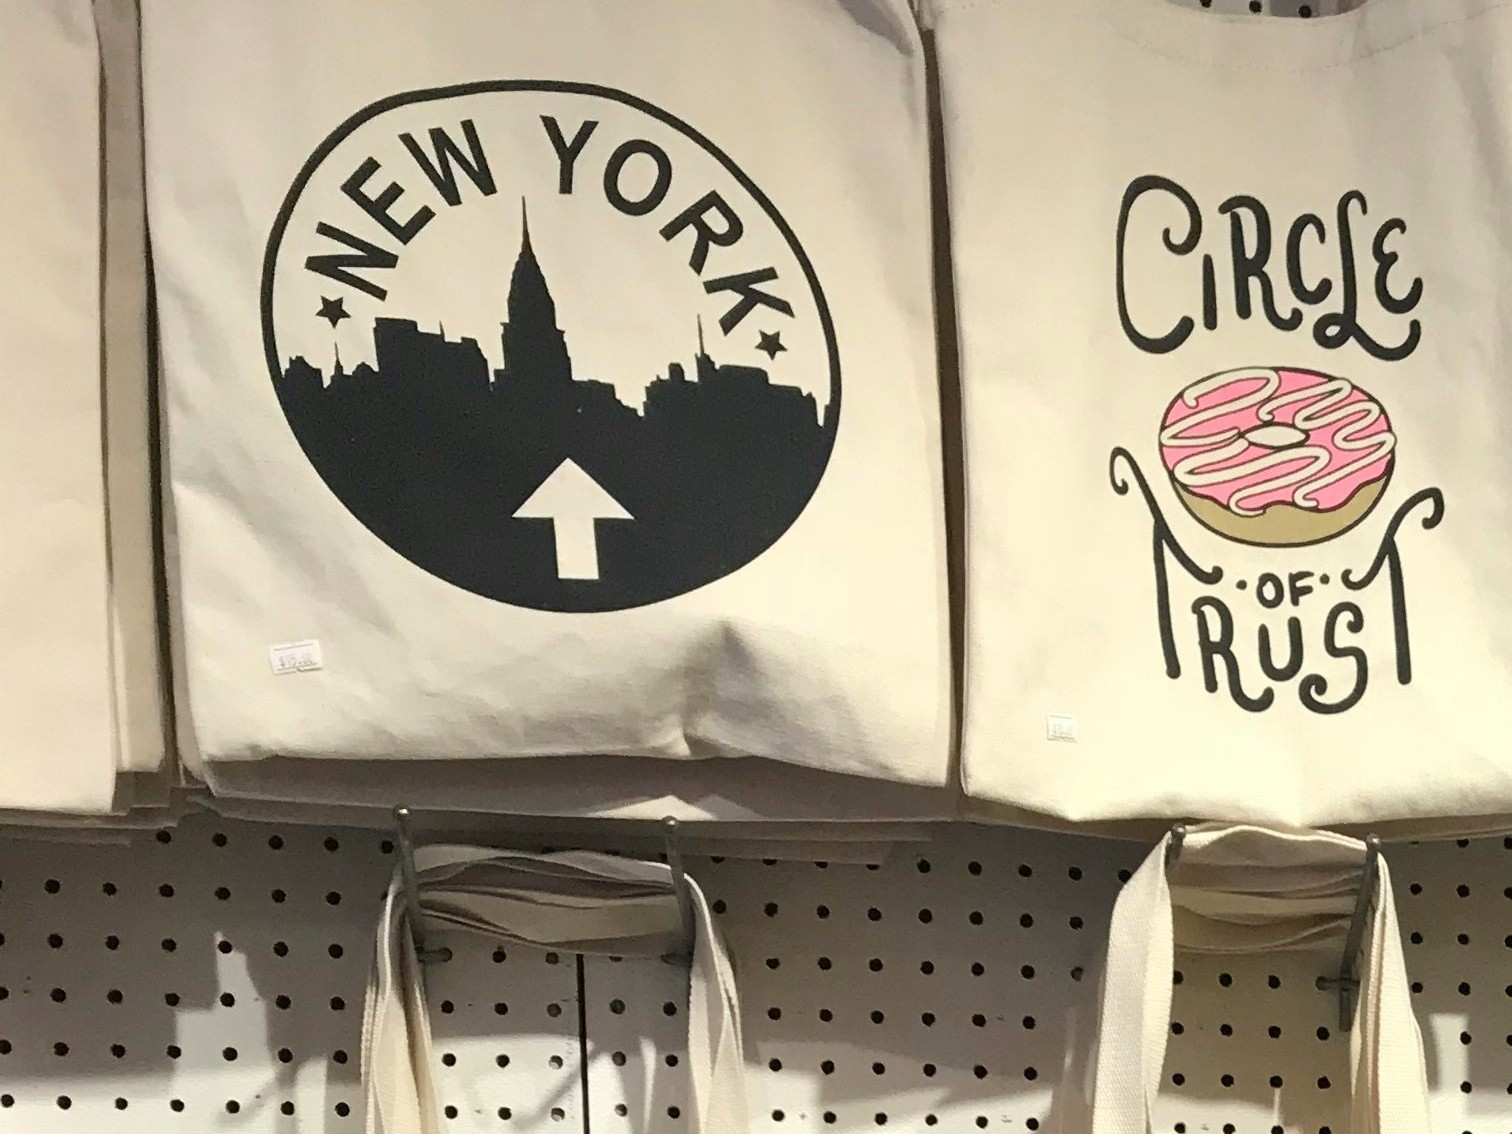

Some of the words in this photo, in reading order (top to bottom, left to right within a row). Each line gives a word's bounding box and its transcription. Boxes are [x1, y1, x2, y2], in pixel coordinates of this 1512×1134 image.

[304, 118, 498, 302] NEW
[539, 113, 796, 337] YORK
[1109, 446, 1445, 716] TRUST
[1256, 570, 1314, 609] OF
